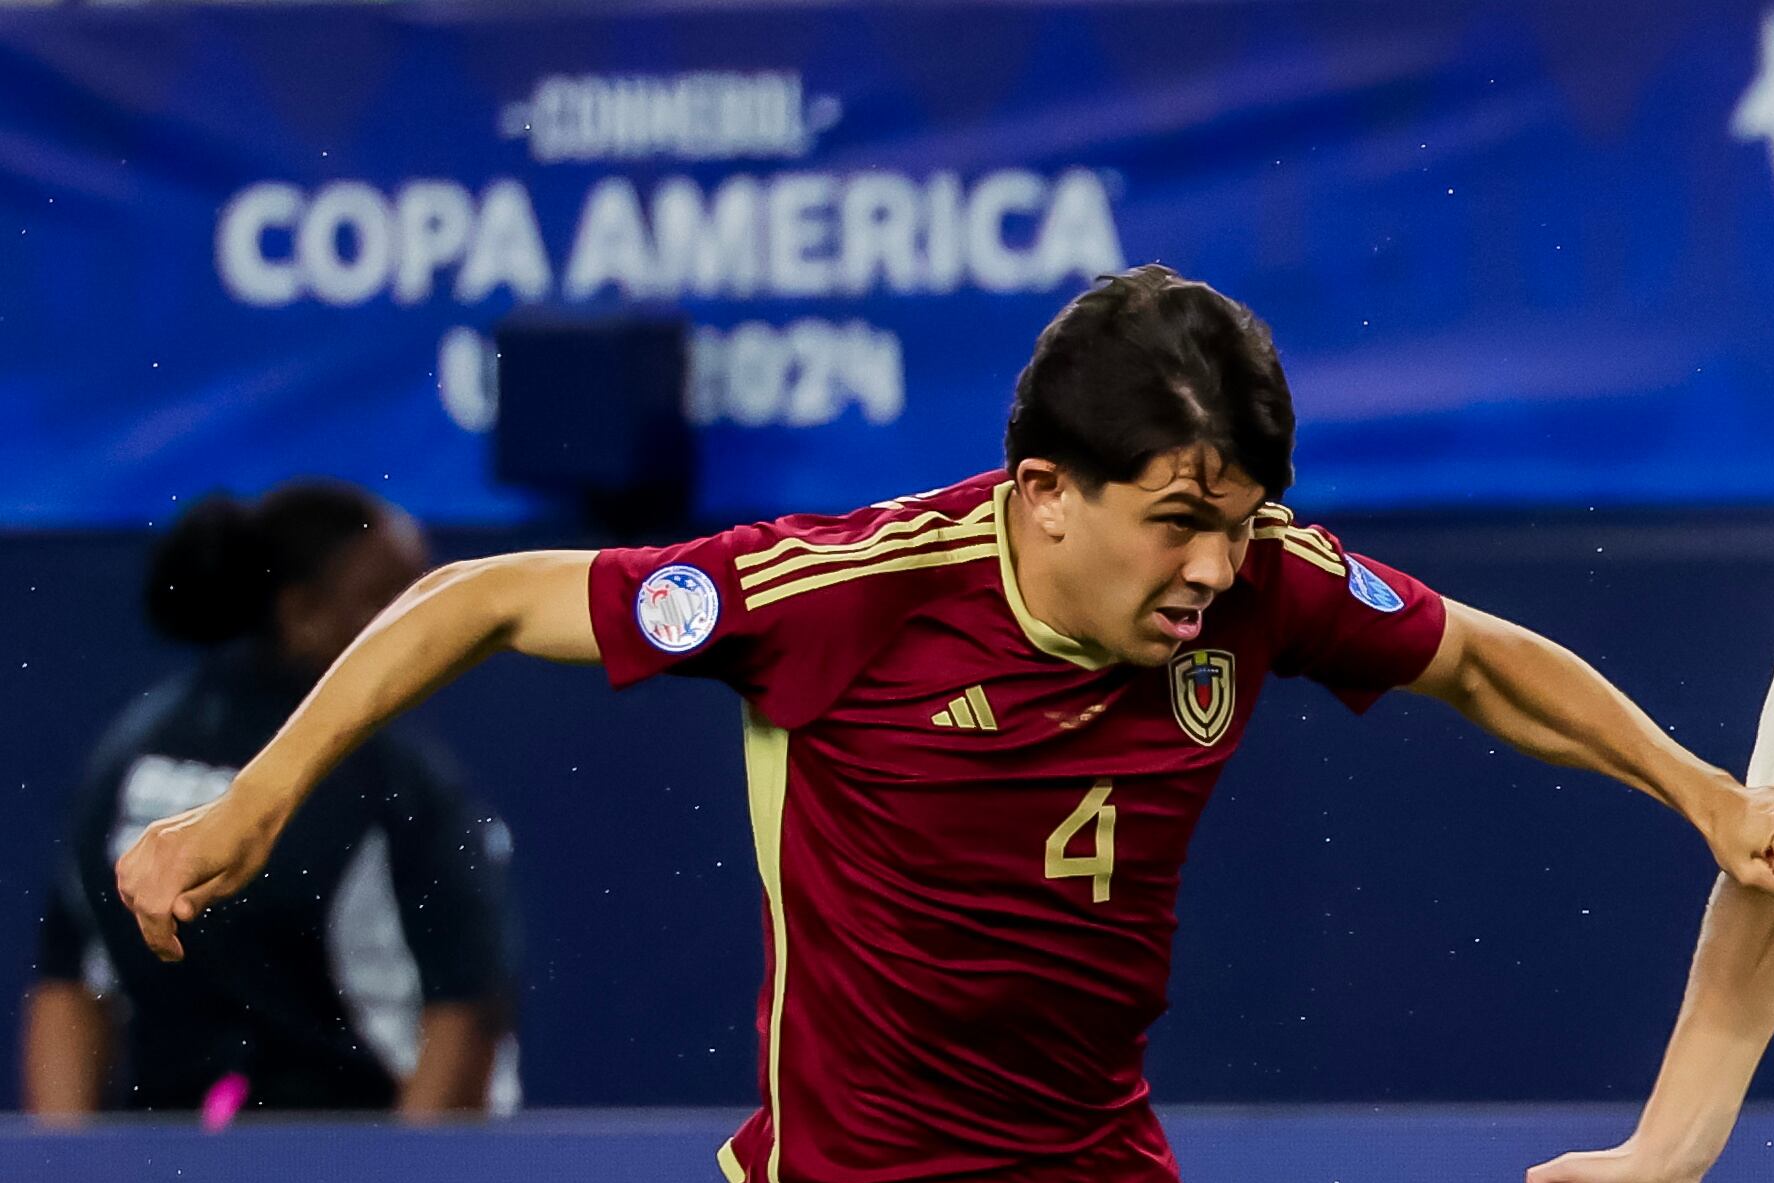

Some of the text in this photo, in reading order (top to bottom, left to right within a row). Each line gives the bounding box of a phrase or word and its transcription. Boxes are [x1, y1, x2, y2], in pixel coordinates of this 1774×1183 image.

[216, 168, 1126, 307] COPA AMERICA
[1044, 779, 1116, 903] 4
